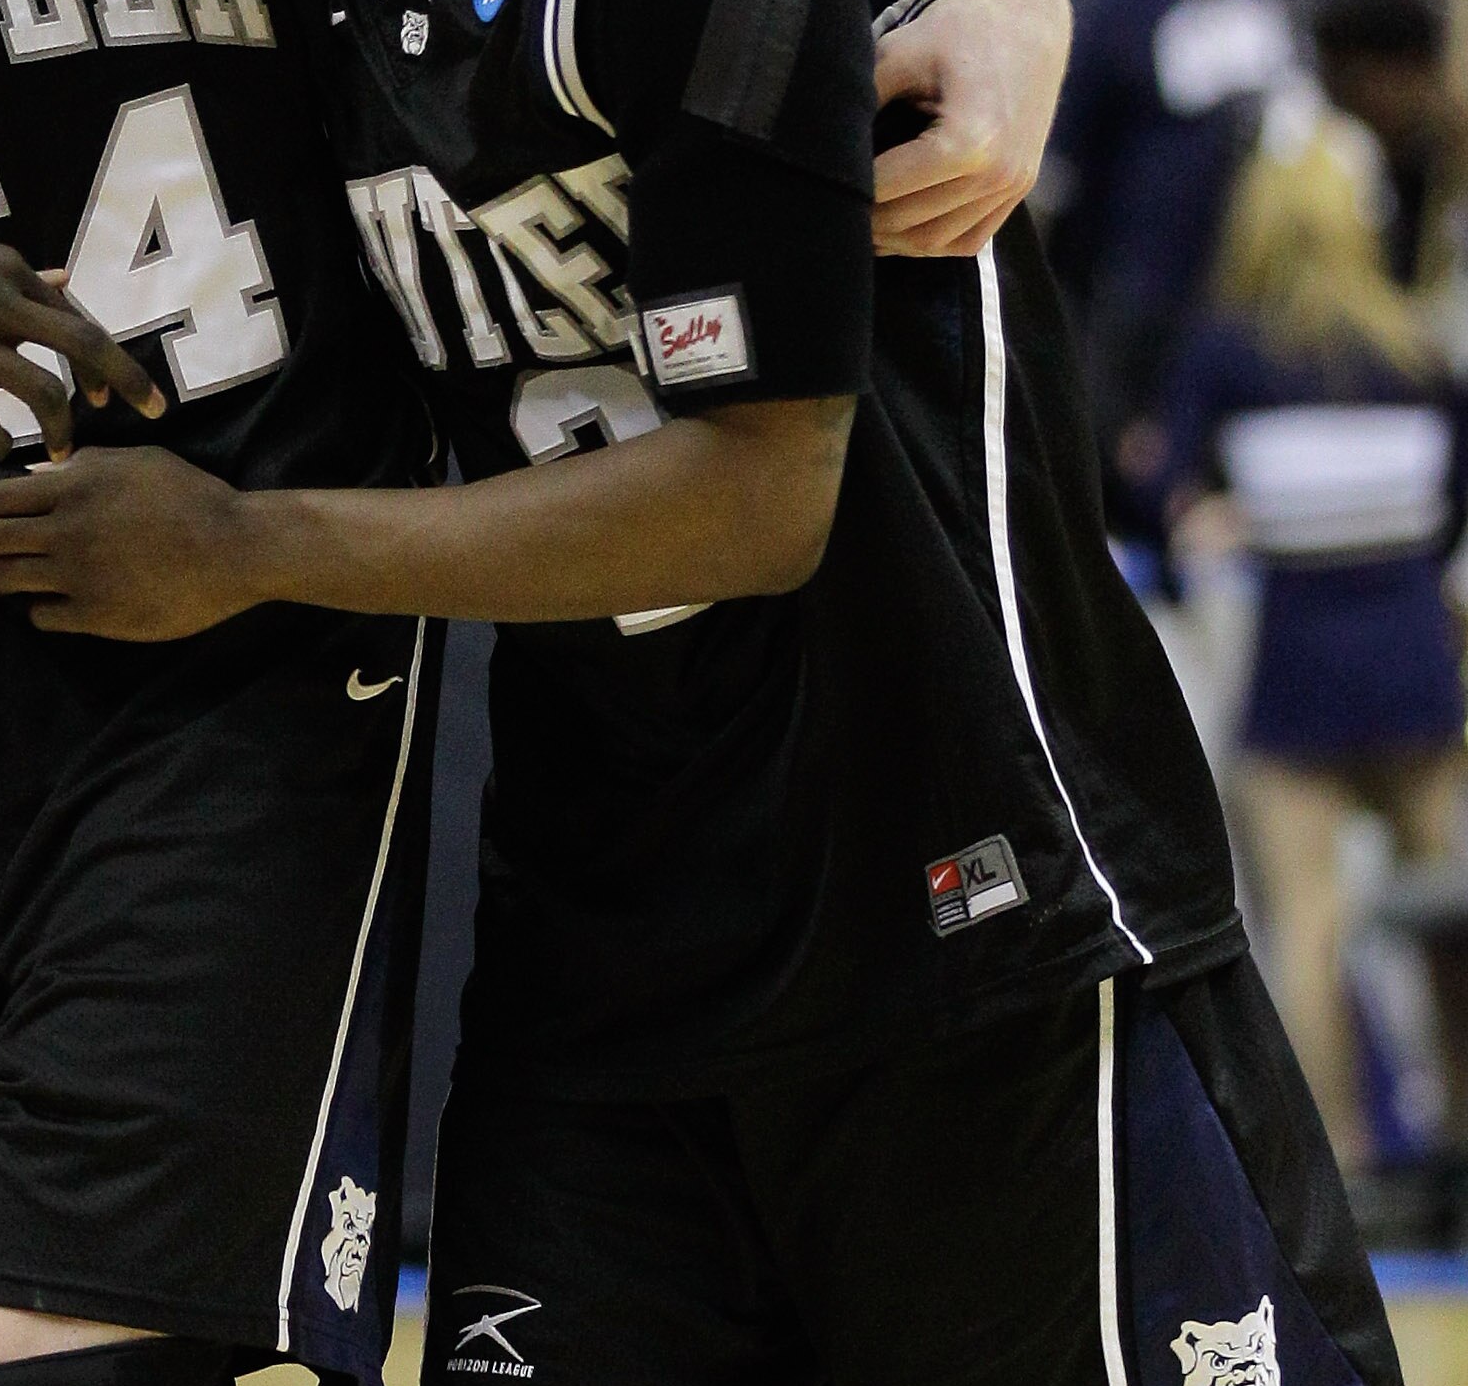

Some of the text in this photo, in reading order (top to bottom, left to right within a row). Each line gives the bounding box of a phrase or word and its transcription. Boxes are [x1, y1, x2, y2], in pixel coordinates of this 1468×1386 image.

[962, 857, 997, 889] XL
[446, 1358, 535, 1379] HORIZON LEAGUE
